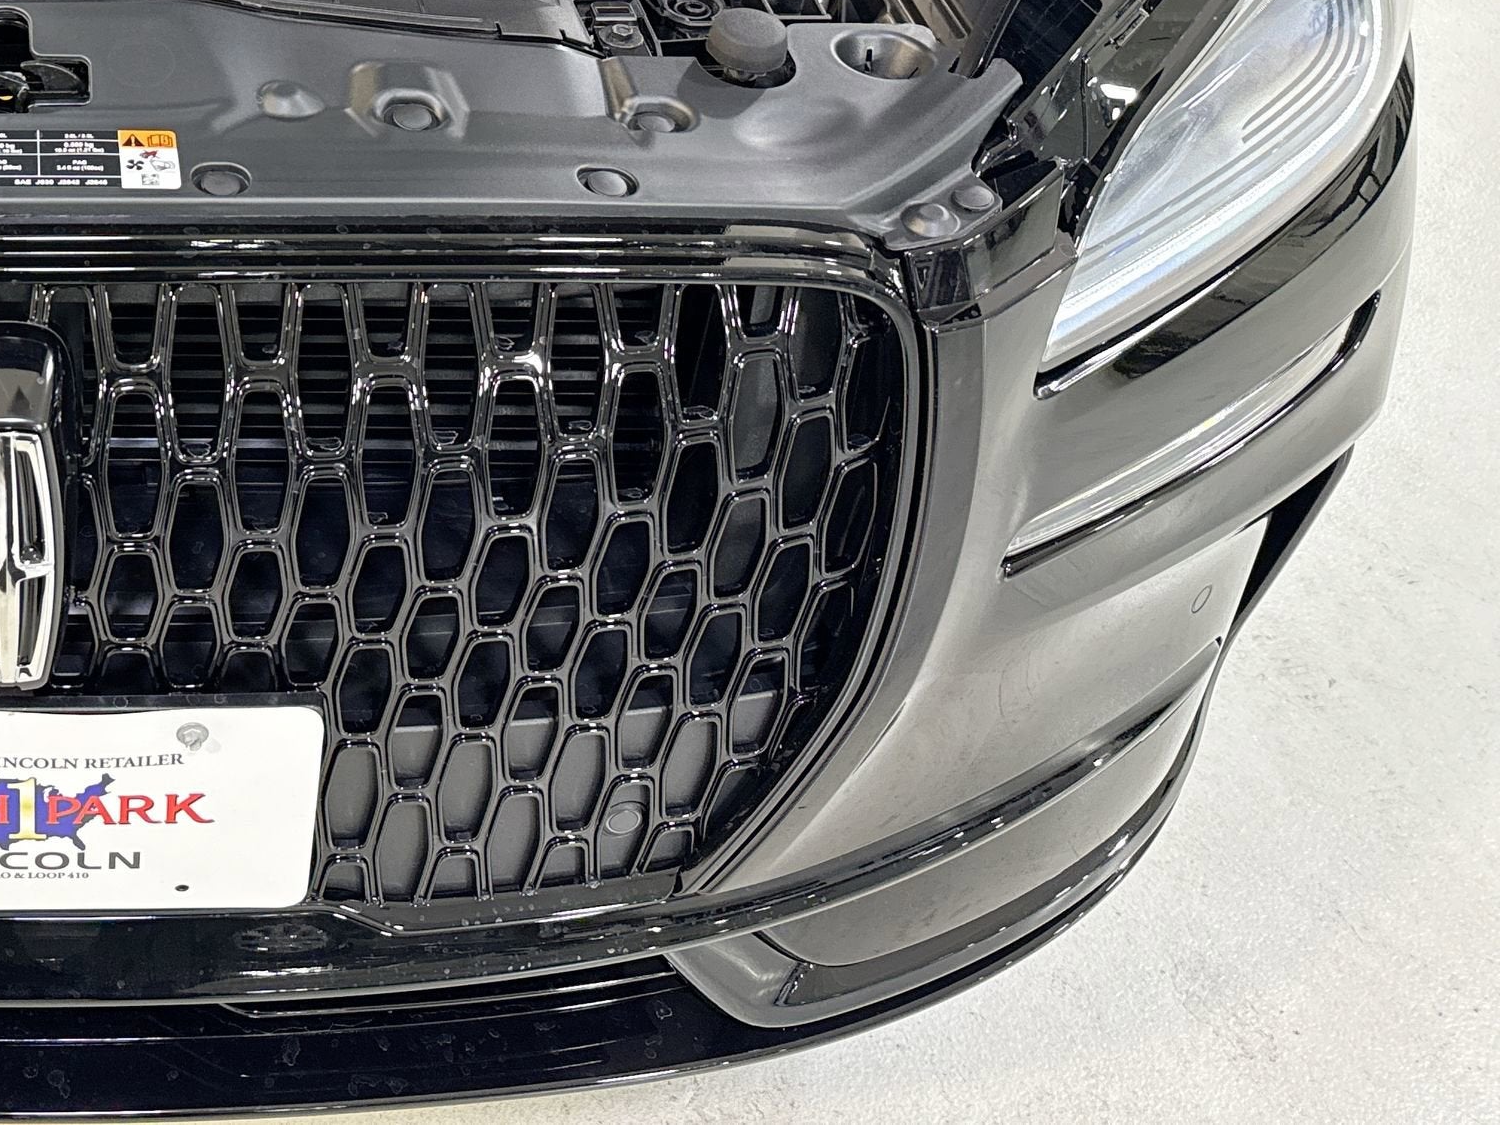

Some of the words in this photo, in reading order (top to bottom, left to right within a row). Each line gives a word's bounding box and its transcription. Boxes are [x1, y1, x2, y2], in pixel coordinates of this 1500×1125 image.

[84, 753, 184, 769] RETAILER
[46, 792, 215, 825] PARK
[14, 871, 25, 879] &
[28, 871, 66, 879] LOOP
[67, 871, 89, 879] 410
